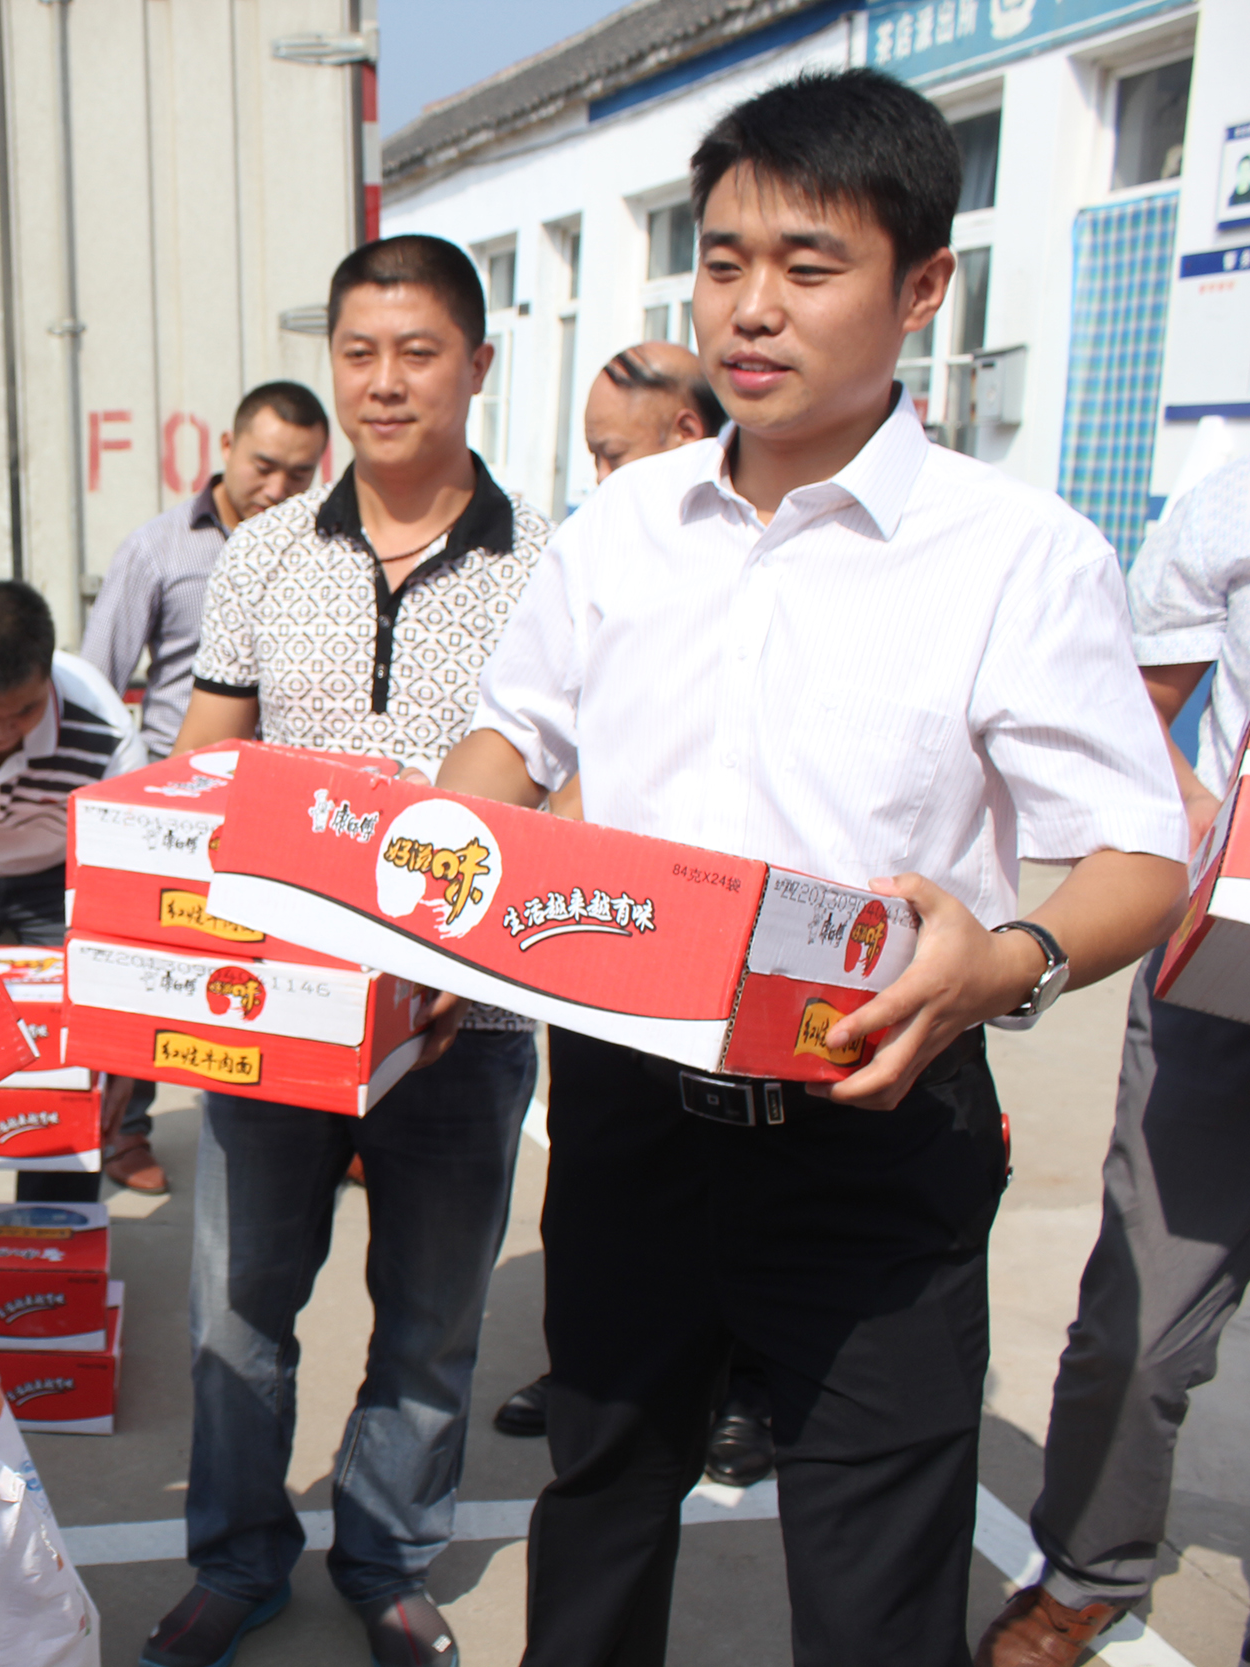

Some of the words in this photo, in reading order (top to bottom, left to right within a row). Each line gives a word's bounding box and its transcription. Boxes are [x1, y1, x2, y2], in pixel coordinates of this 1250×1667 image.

[383, 836, 491, 924] 好滋味
[502, 886, 657, 938] 生活越来越有味
[161, 1040, 253, 1076] 红烧牛肉面
